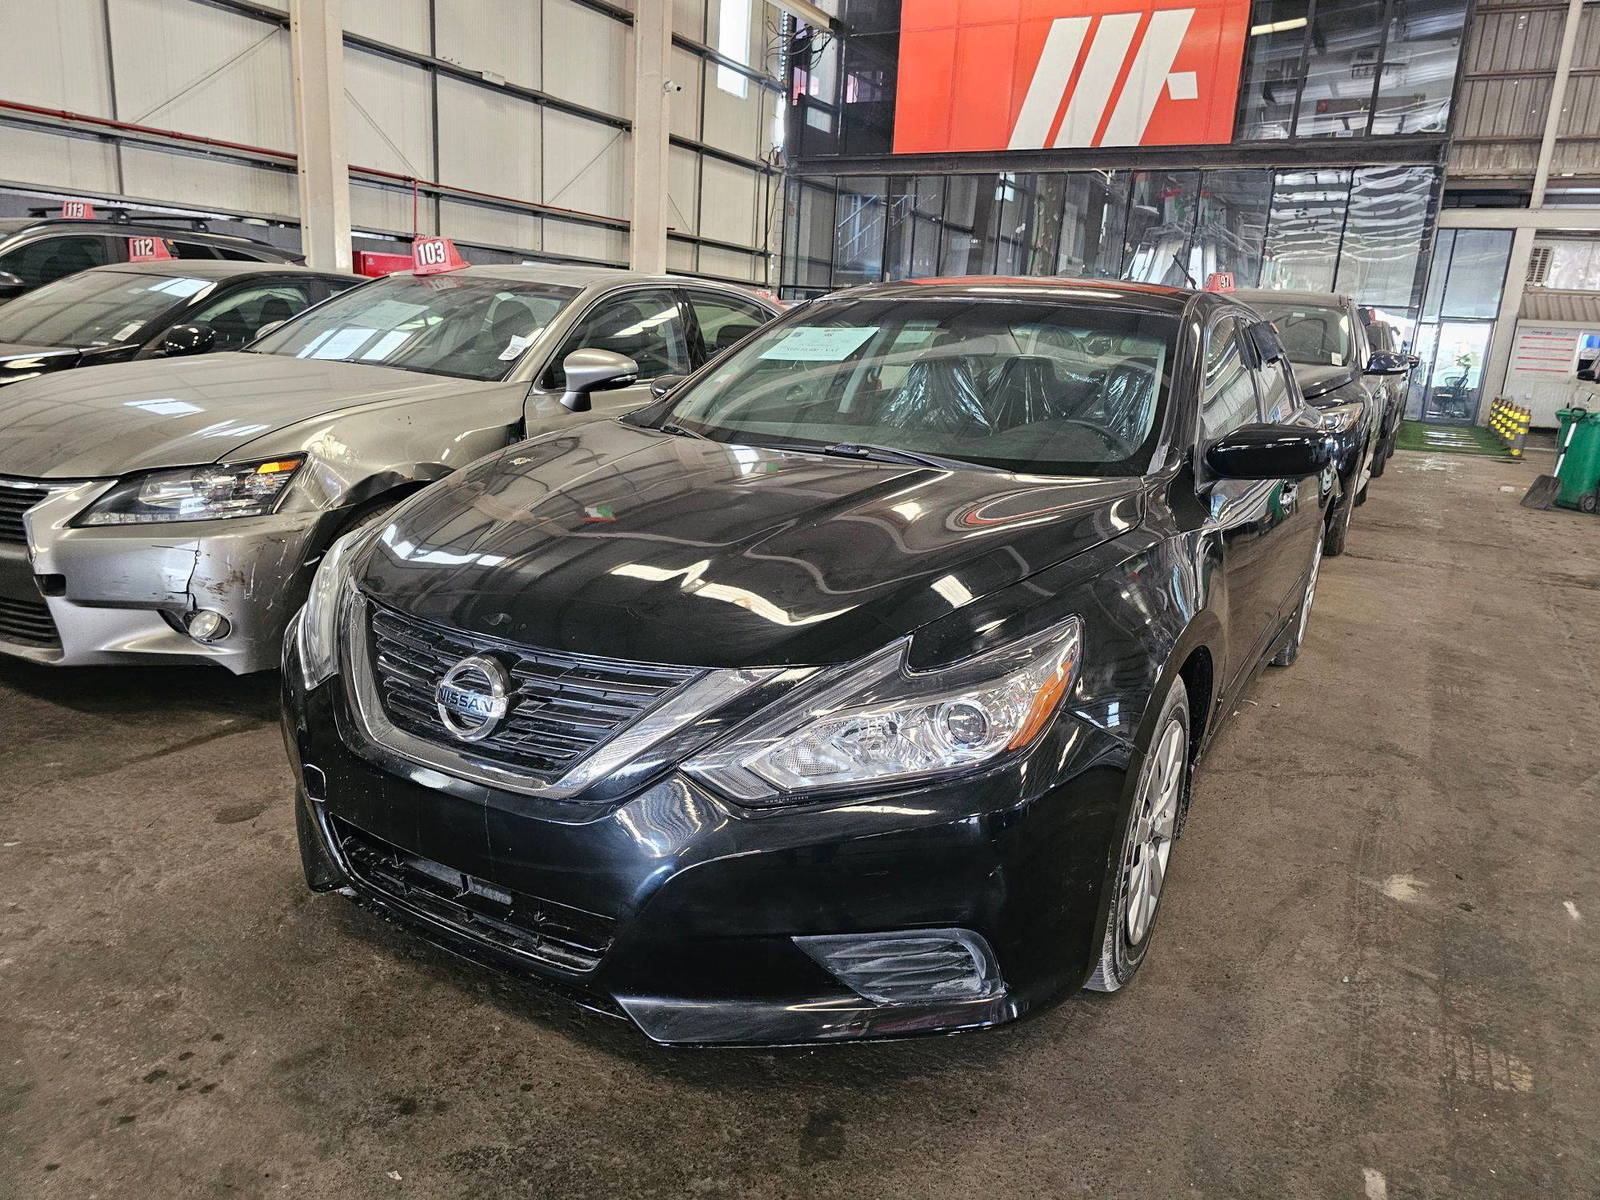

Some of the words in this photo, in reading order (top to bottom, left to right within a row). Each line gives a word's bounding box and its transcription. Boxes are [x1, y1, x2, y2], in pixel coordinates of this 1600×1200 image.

[67, 202, 84, 217] 113
[134, 239, 153, 256] 112
[418, 241, 446, 266] 103
[438, 687, 494, 713] NISSAN
